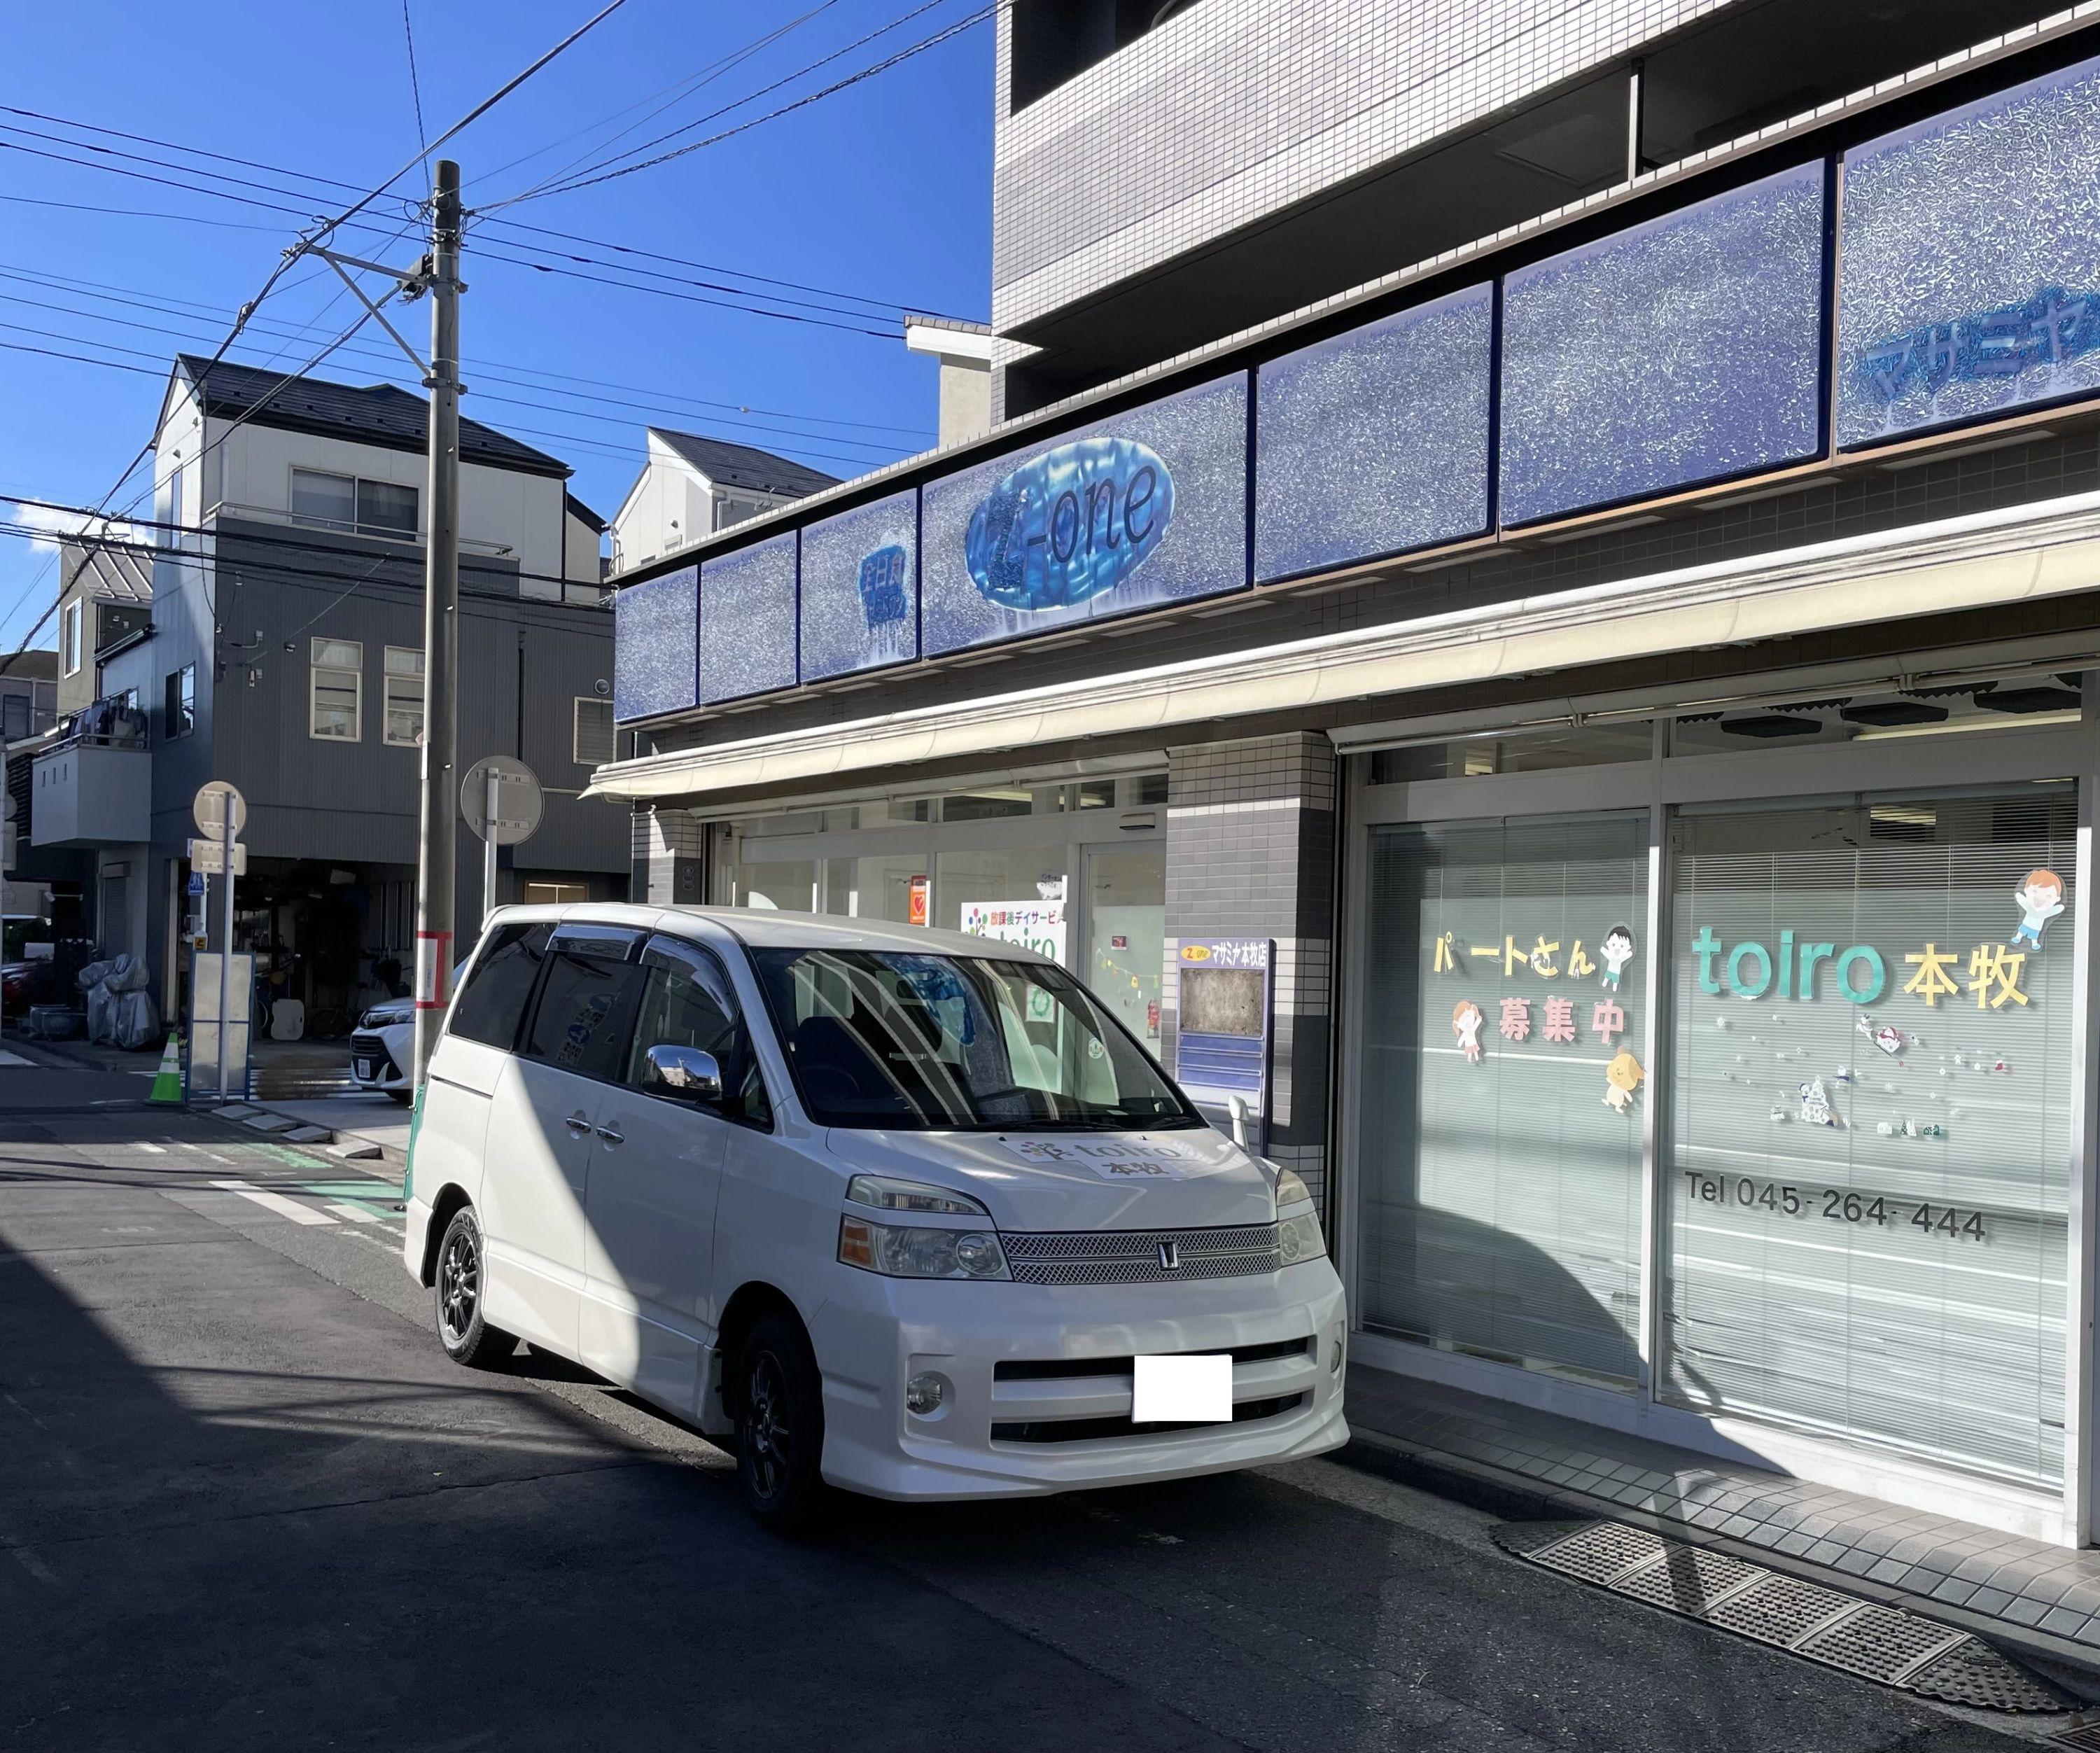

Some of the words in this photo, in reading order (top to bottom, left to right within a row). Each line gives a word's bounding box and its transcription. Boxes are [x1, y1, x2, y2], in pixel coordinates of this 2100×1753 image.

[1212, 942, 1267, 967] マサミヤ本牧店
[1434, 931, 1596, 978] パートさん
[1692, 926, 1886, 1004] toiro
[1903, 943, 2029, 1009] 本牧
[1499, 998, 1624, 1044] 募集中
[1074, 1143, 1182, 1158] toiro
[1685, 1171, 1725, 1203] Tel
